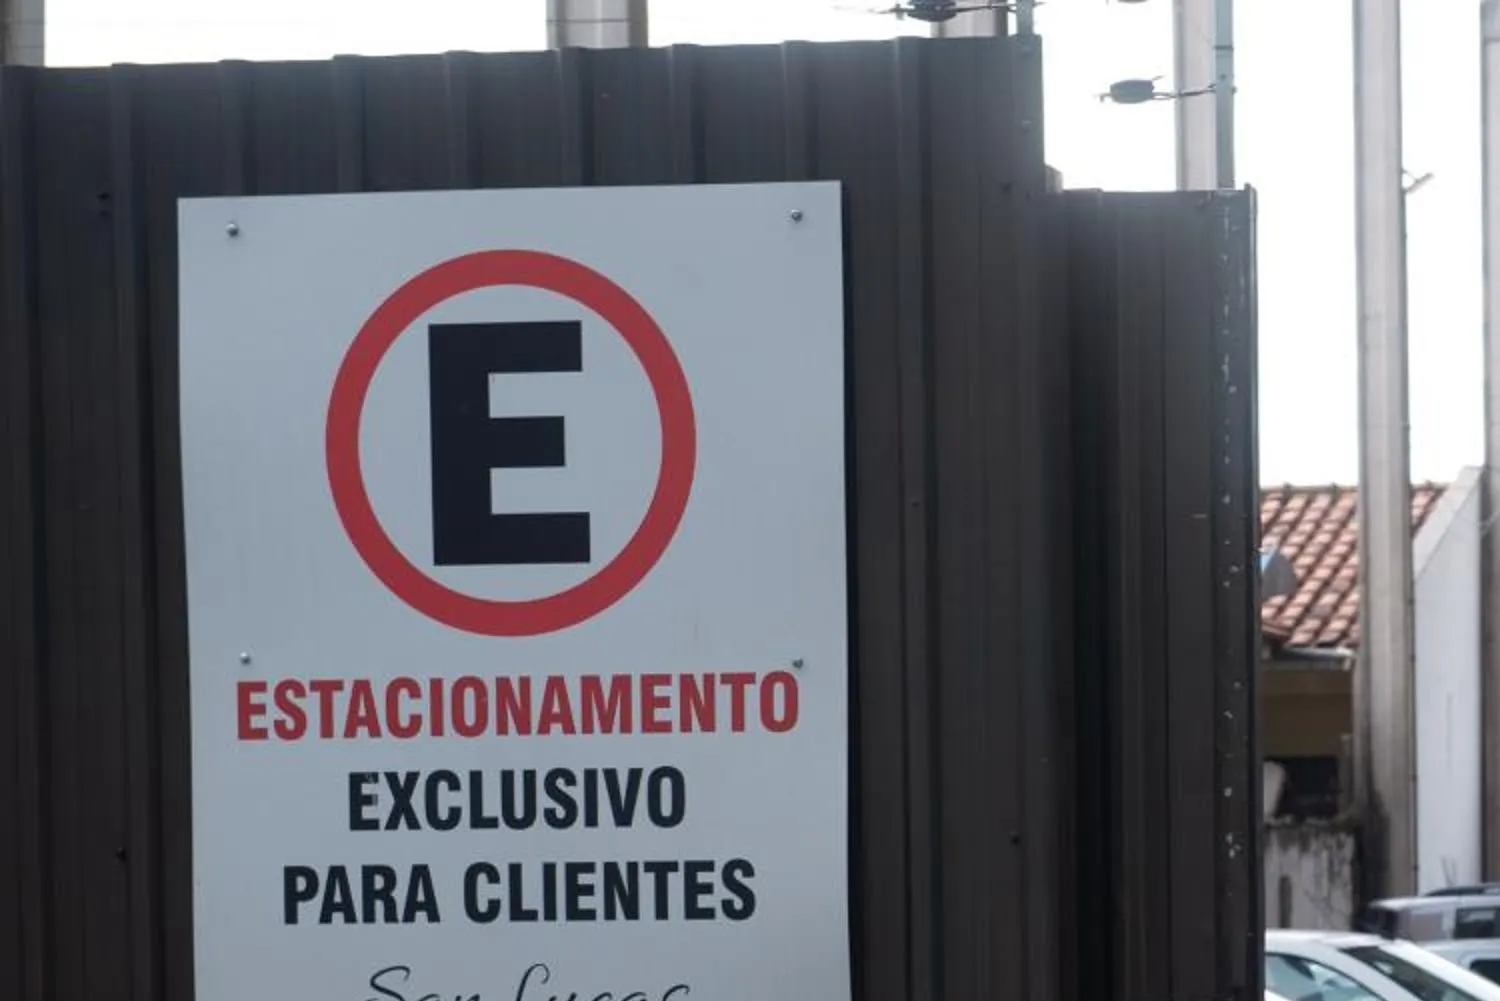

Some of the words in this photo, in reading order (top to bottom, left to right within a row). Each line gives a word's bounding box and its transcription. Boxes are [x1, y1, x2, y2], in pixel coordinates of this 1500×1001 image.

[428, 320, 591, 566] E
[236, 671, 800, 741] ESTACIONAMENTO
[348, 766, 687, 832] EXCLUSIVO
[283, 864, 442, 926] PARA
[463, 858, 757, 925] CLIENTES
